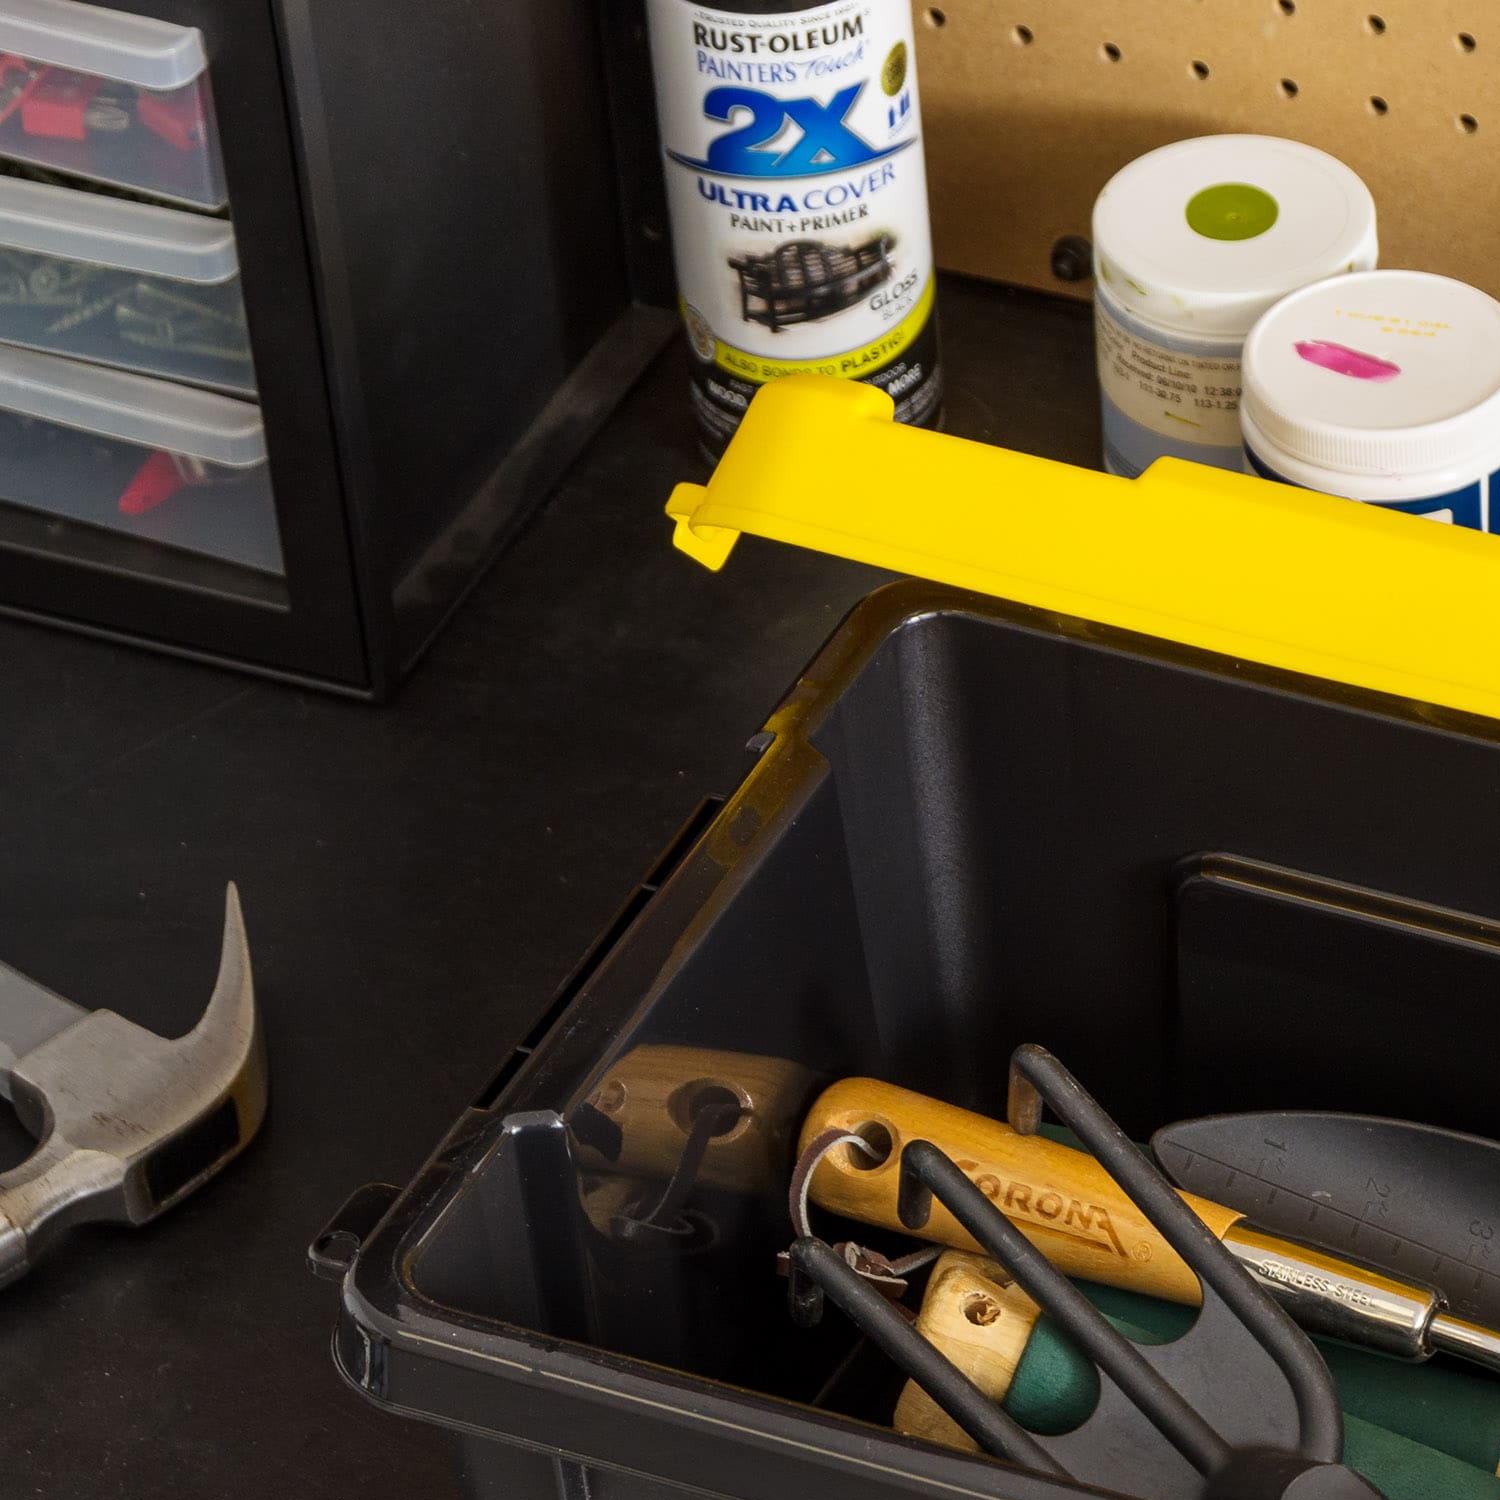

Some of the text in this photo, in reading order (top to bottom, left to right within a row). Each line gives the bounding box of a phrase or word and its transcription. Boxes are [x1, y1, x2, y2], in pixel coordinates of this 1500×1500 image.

[693, 15, 864, 53] RUST-OLEUM
[703, 80, 878, 174] 2X
[802, 162, 896, 211] COVER
[869, 269, 918, 311] GLOSS
[724, 352, 758, 373] ALSO
[816, 364, 836, 376] TO
[1131, 350, 1166, 373] Product
[1204, 385, 1242, 396] 12:38:0
[954, 1159, 1128, 1258] ORONA
[1257, 1259, 1376, 1308] STAINLESS STEEL
